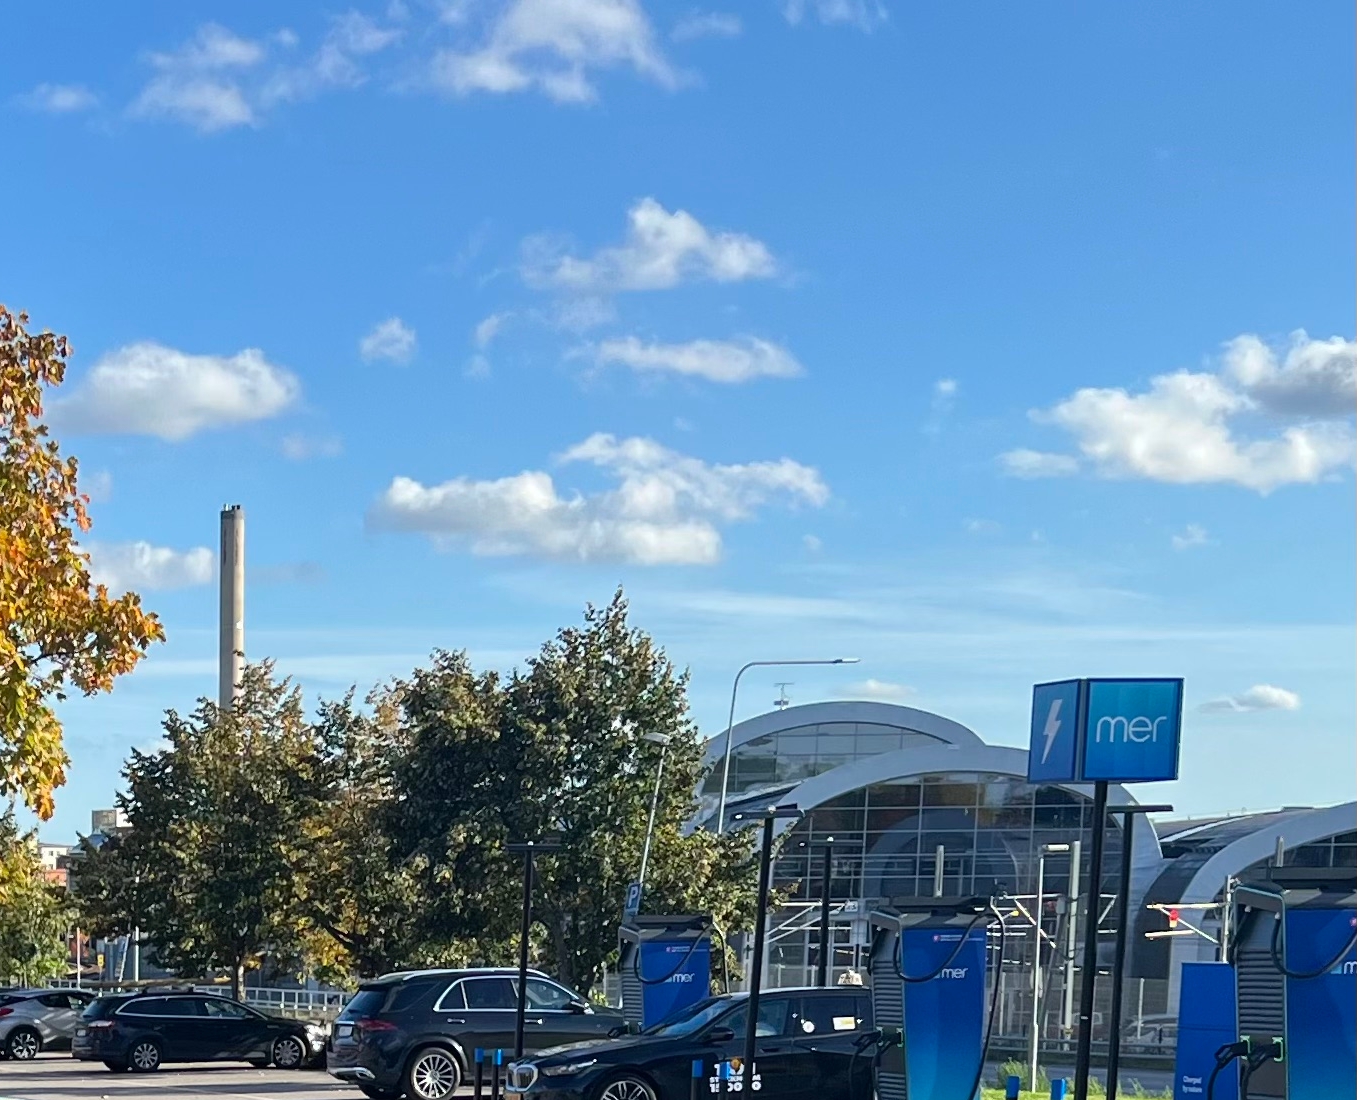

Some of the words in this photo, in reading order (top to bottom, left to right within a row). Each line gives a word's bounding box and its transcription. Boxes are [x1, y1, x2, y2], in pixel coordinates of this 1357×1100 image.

[1095, 715, 1168, 743] mer
[671, 973, 696, 983] mer
[941, 967, 969, 979] mer
